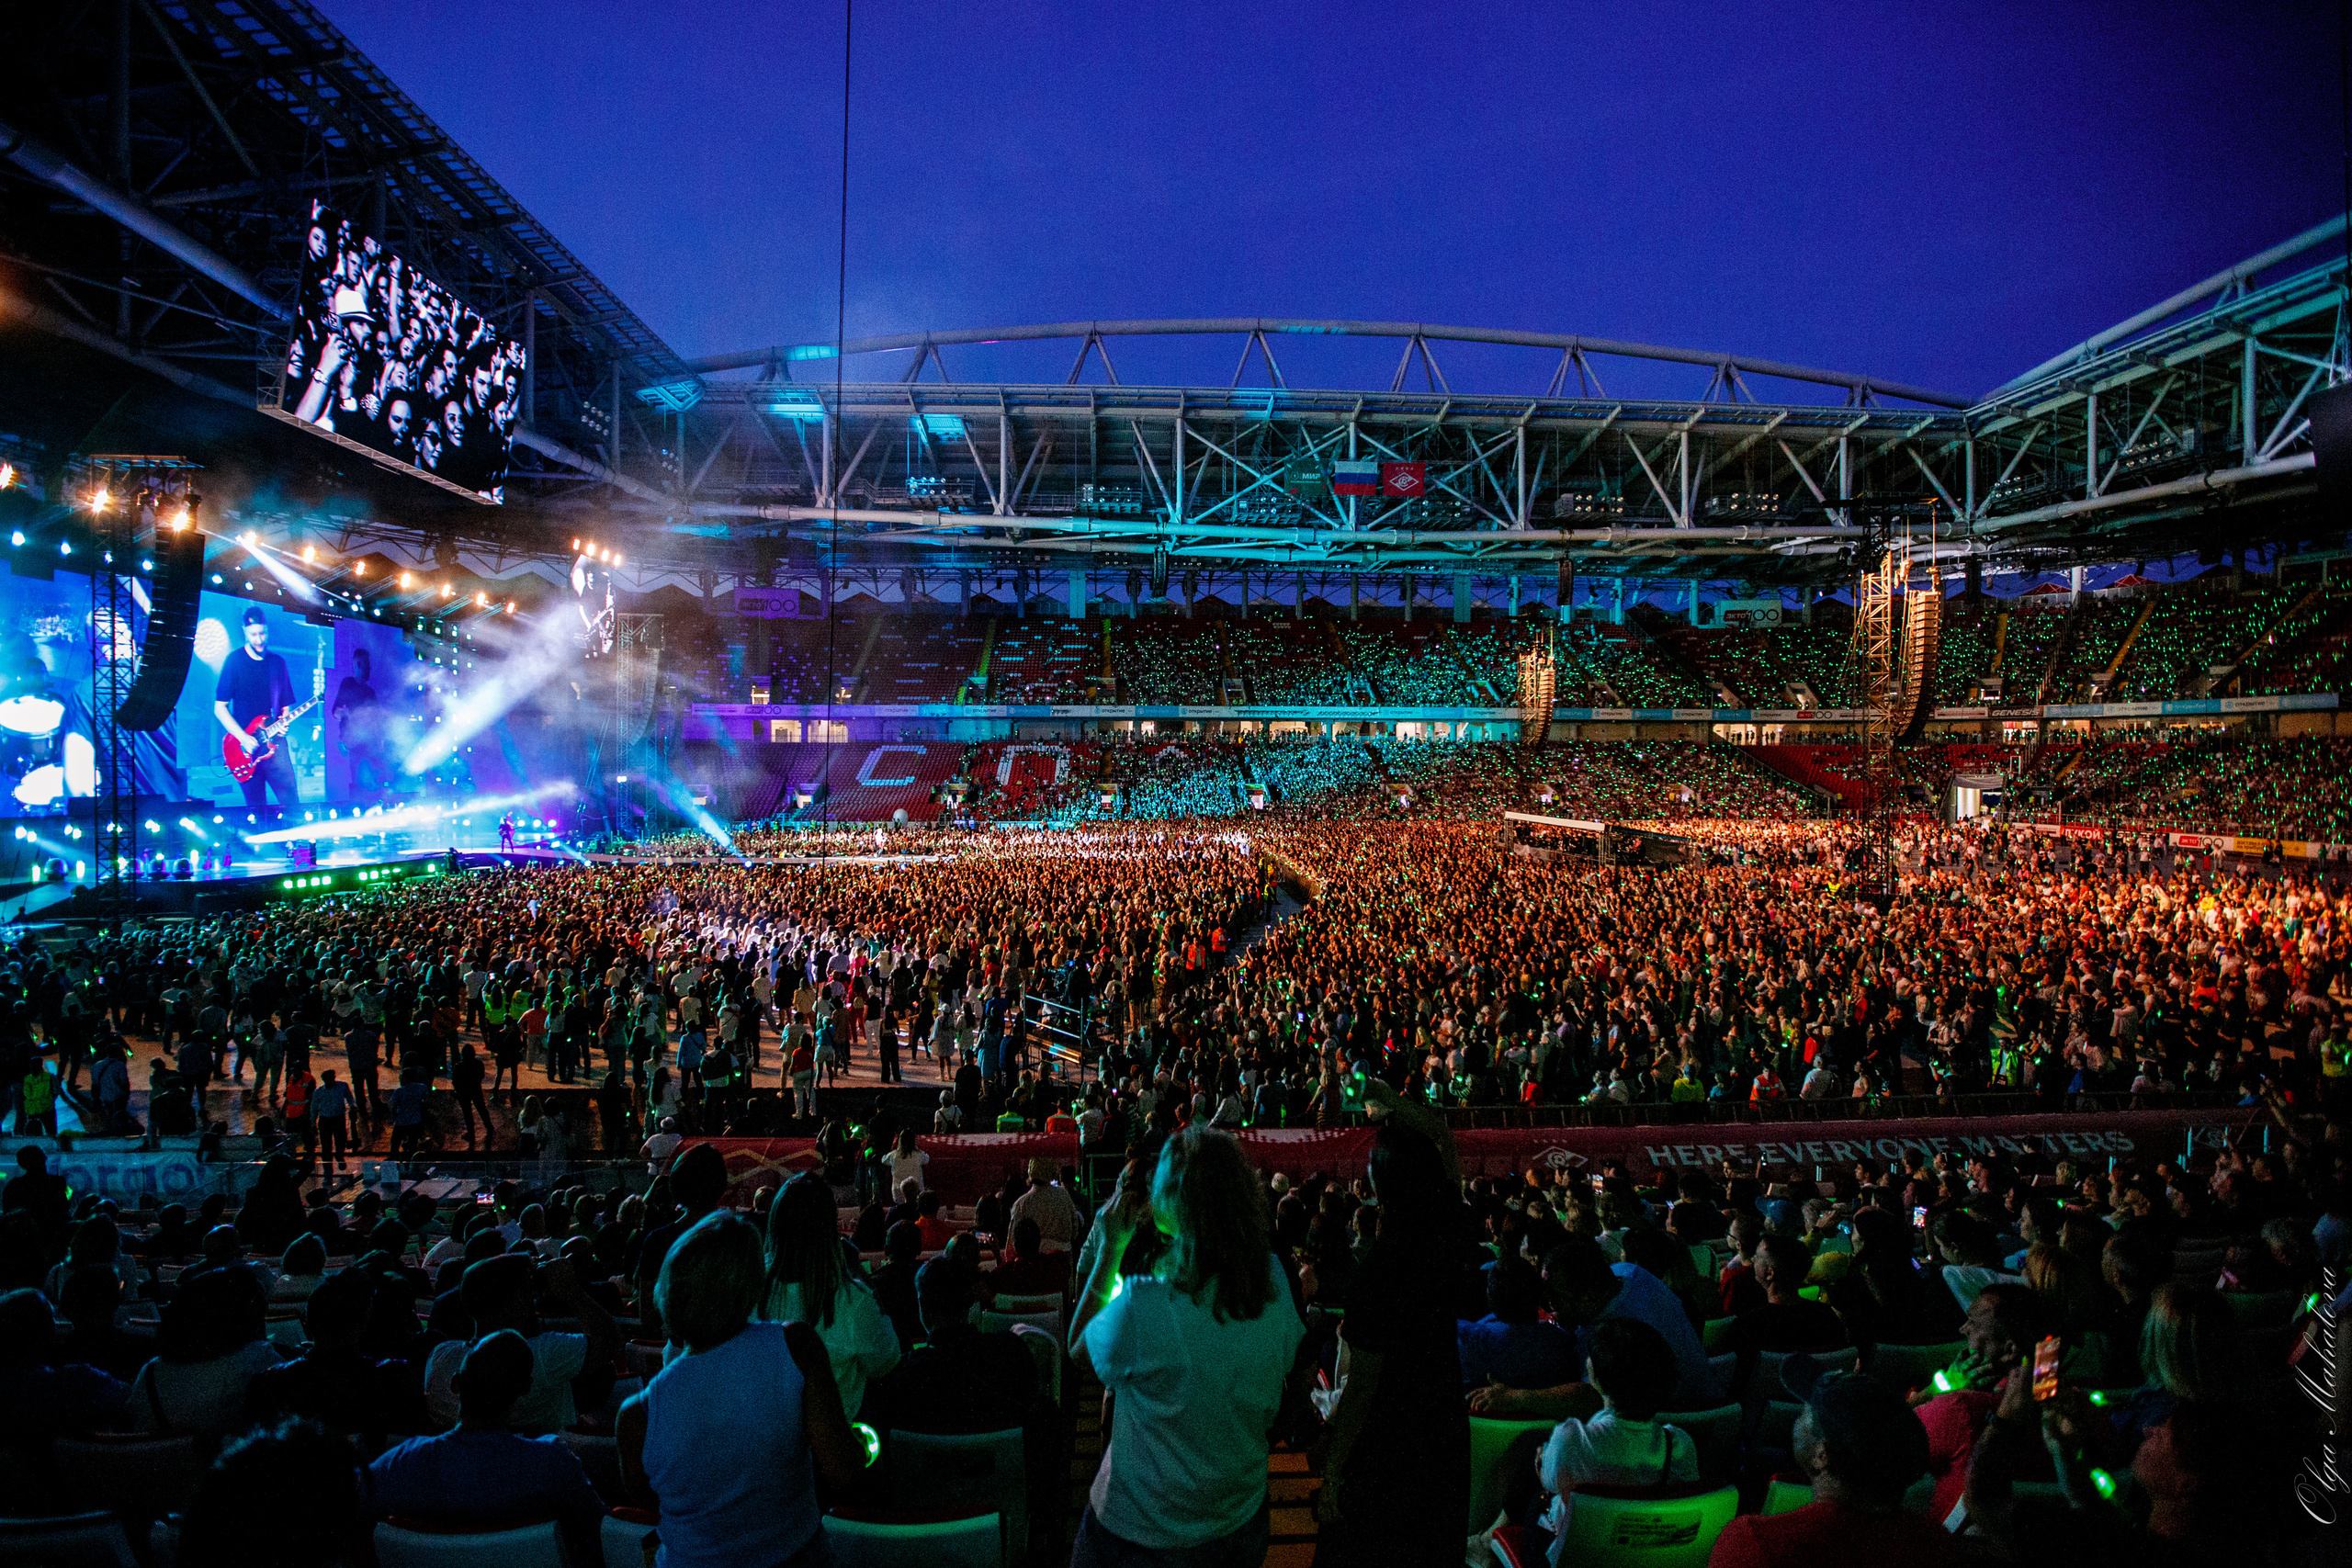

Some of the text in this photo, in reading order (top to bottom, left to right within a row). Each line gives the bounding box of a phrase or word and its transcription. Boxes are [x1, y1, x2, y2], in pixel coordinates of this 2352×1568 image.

[1747, 609, 1779, 622] 100
[1992, 708, 2041, 717] GENESIS
[1644, 1144, 1753, 1168] HERE
[1756, 1136, 1950, 1166] EVERYONE
